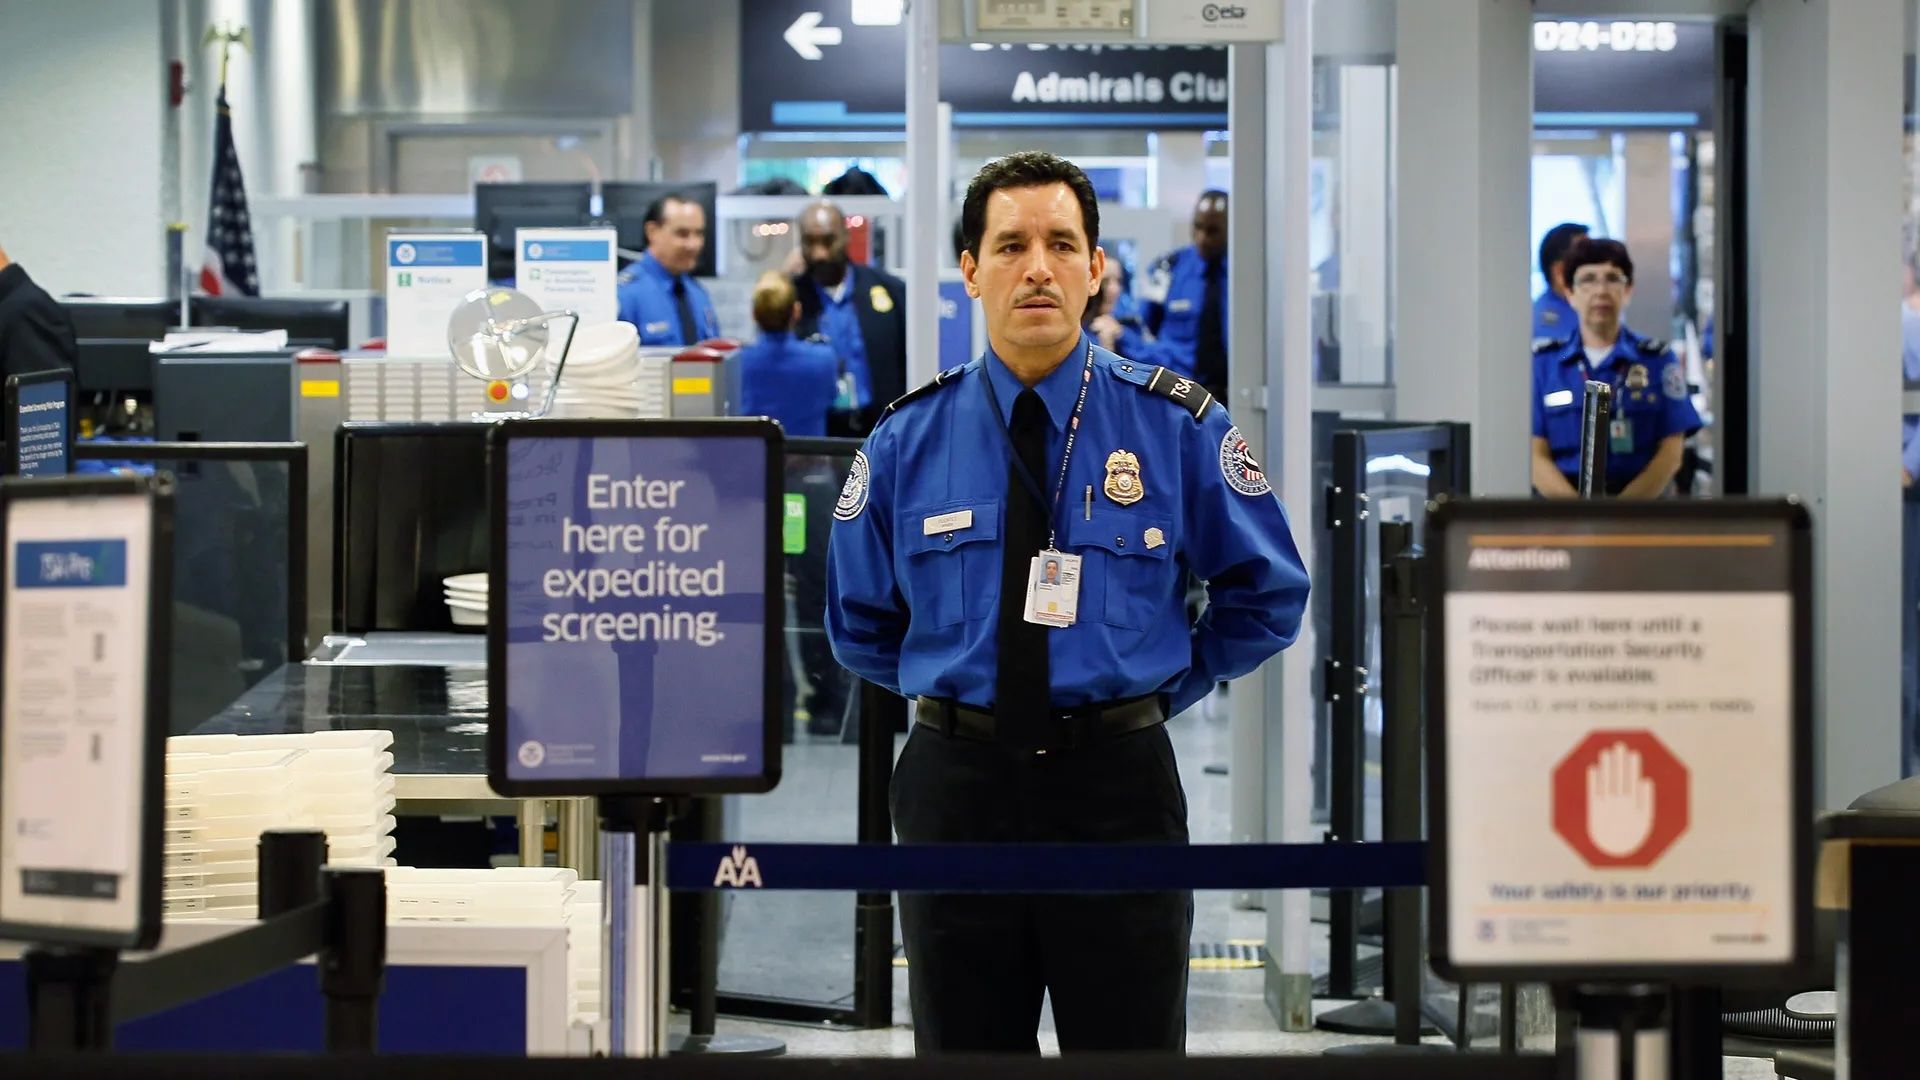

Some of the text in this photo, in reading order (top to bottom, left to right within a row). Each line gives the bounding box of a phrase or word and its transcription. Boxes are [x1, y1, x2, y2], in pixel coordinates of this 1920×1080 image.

[1533, 20, 1677, 51] D24-D25
[1011, 71, 1227, 103] Admirals Clu
[1170, 377, 1195, 399] TSA
[587, 474, 685, 509] Enter
[562, 516, 709, 553] here for
[1468, 548, 1571, 570] Attention
[542, 560, 725, 604] expedited
[542, 603, 725, 647] screening.
[1469, 616, 1533, 634] Please
[1541, 616, 1581, 633] wait
[1591, 616, 1633, 633] here
[1639, 616, 1683, 633] until
[1471, 640, 1705, 662] Transportation Security
[1468, 666, 1538, 685] Officer
[1490, 883, 1536, 899] Your
[1541, 882, 1605, 902] safety
[1633, 885, 1667, 899] our
[1671, 882, 1754, 902] priority
